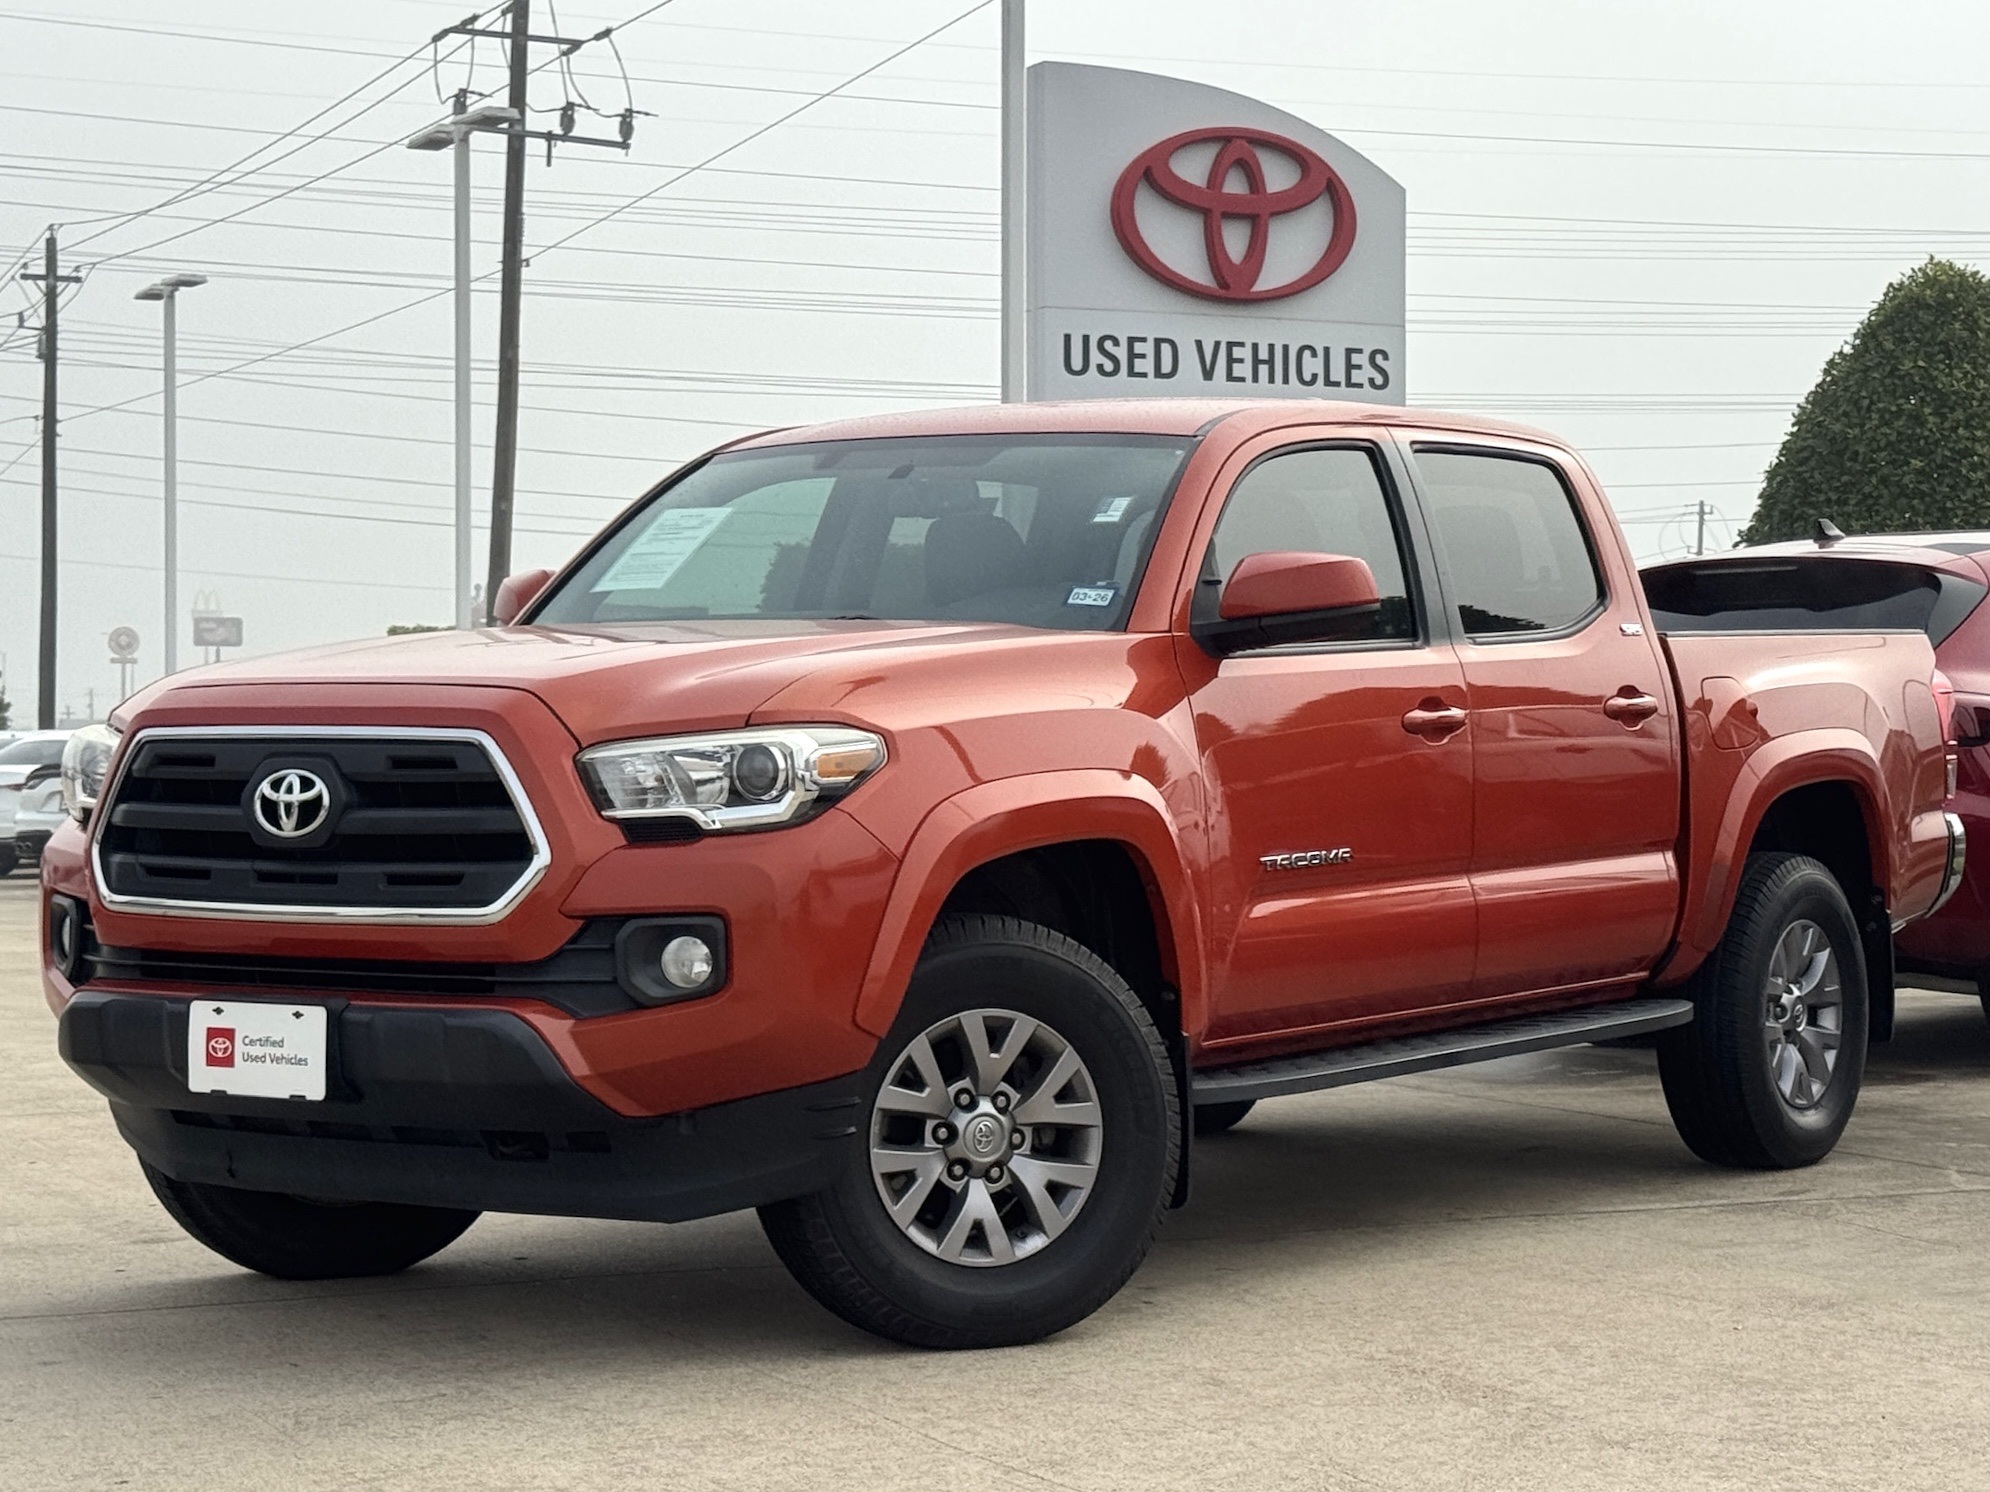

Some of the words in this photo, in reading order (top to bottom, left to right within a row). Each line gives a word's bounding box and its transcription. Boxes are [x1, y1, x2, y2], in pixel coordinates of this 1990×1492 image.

[1063, 333, 1180, 380] USED
[1195, 339, 1390, 391] VEHICLES
[1259, 847, 1352, 871] TACOMA
[242, 1035, 284, 1048] Certified
[242, 1051, 267, 1063] Used
[269, 1053, 309, 1067] Vehicles
